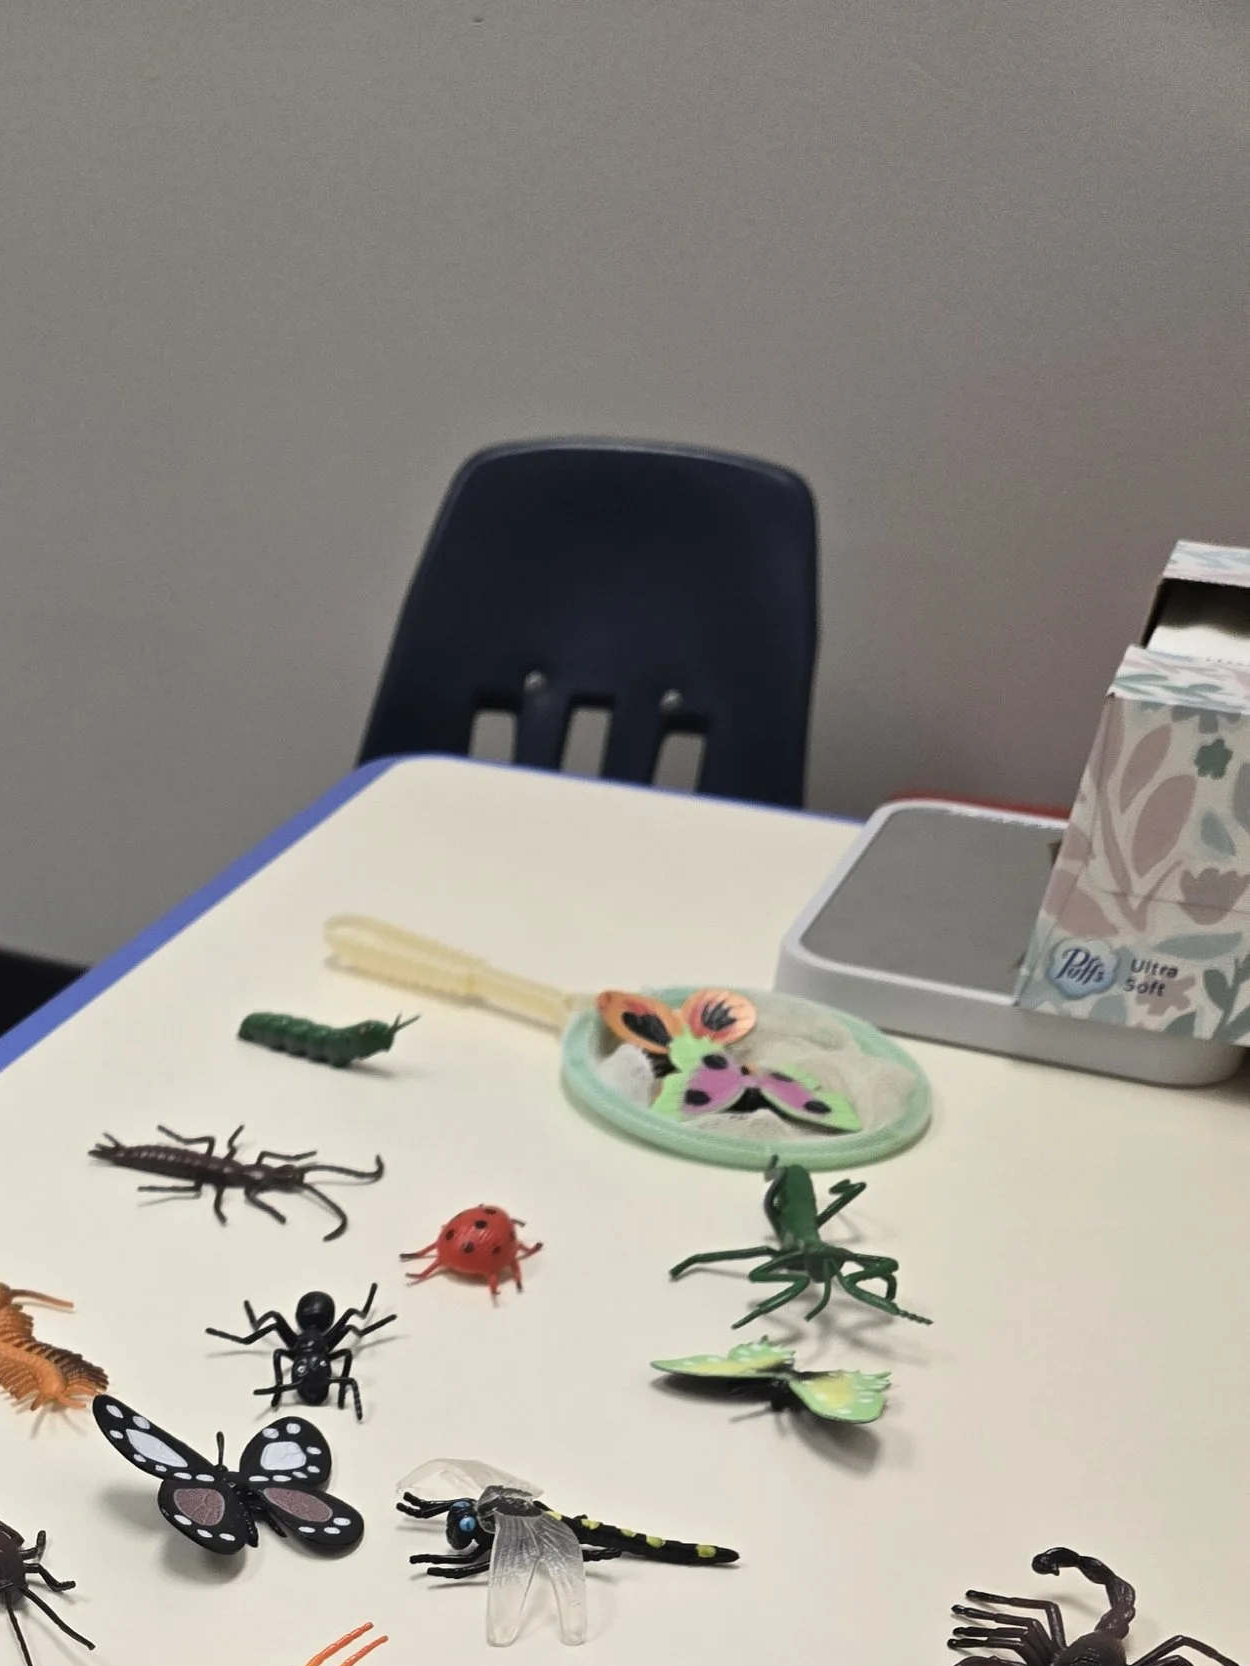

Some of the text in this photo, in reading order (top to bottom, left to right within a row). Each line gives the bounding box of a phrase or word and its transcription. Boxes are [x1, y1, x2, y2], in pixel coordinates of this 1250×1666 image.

[1055, 948, 1104, 985] Puffs
[1130, 958, 1179, 979] Ultra
[1123, 978, 1166, 997] Soft
